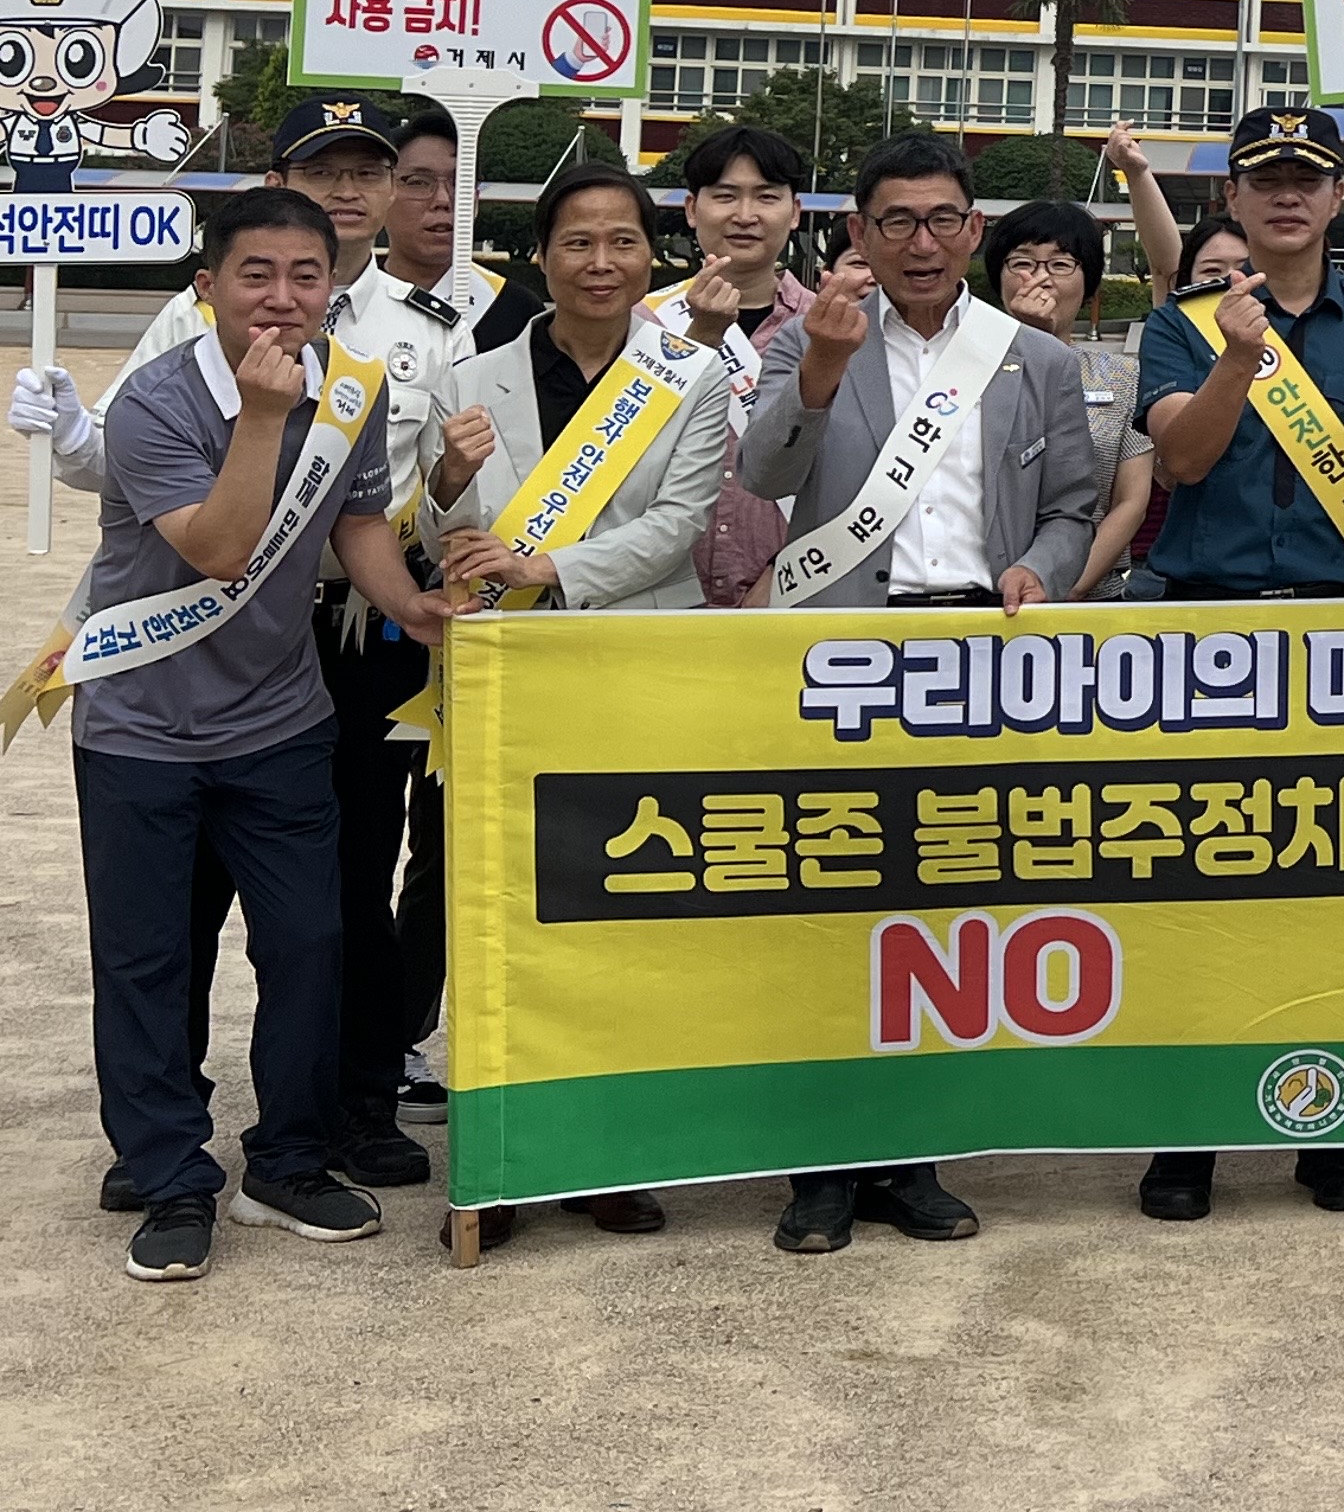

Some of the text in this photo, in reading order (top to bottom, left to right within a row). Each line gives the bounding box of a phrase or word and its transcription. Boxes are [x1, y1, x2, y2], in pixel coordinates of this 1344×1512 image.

[130, 206, 181, 245] OK
[295, 454, 330, 509] 함께
[527, 377, 654, 541] 보행자 안전 우선
[220, 507, 301, 602] 만들어요
[82, 619, 143, 663] 거제시
[146, 595, 225, 645] 안전한
[799, 627, 1290, 740] 우리아이의
[603, 793, 886, 894] 스쿨존
[870, 905, 1122, 1053] NO
